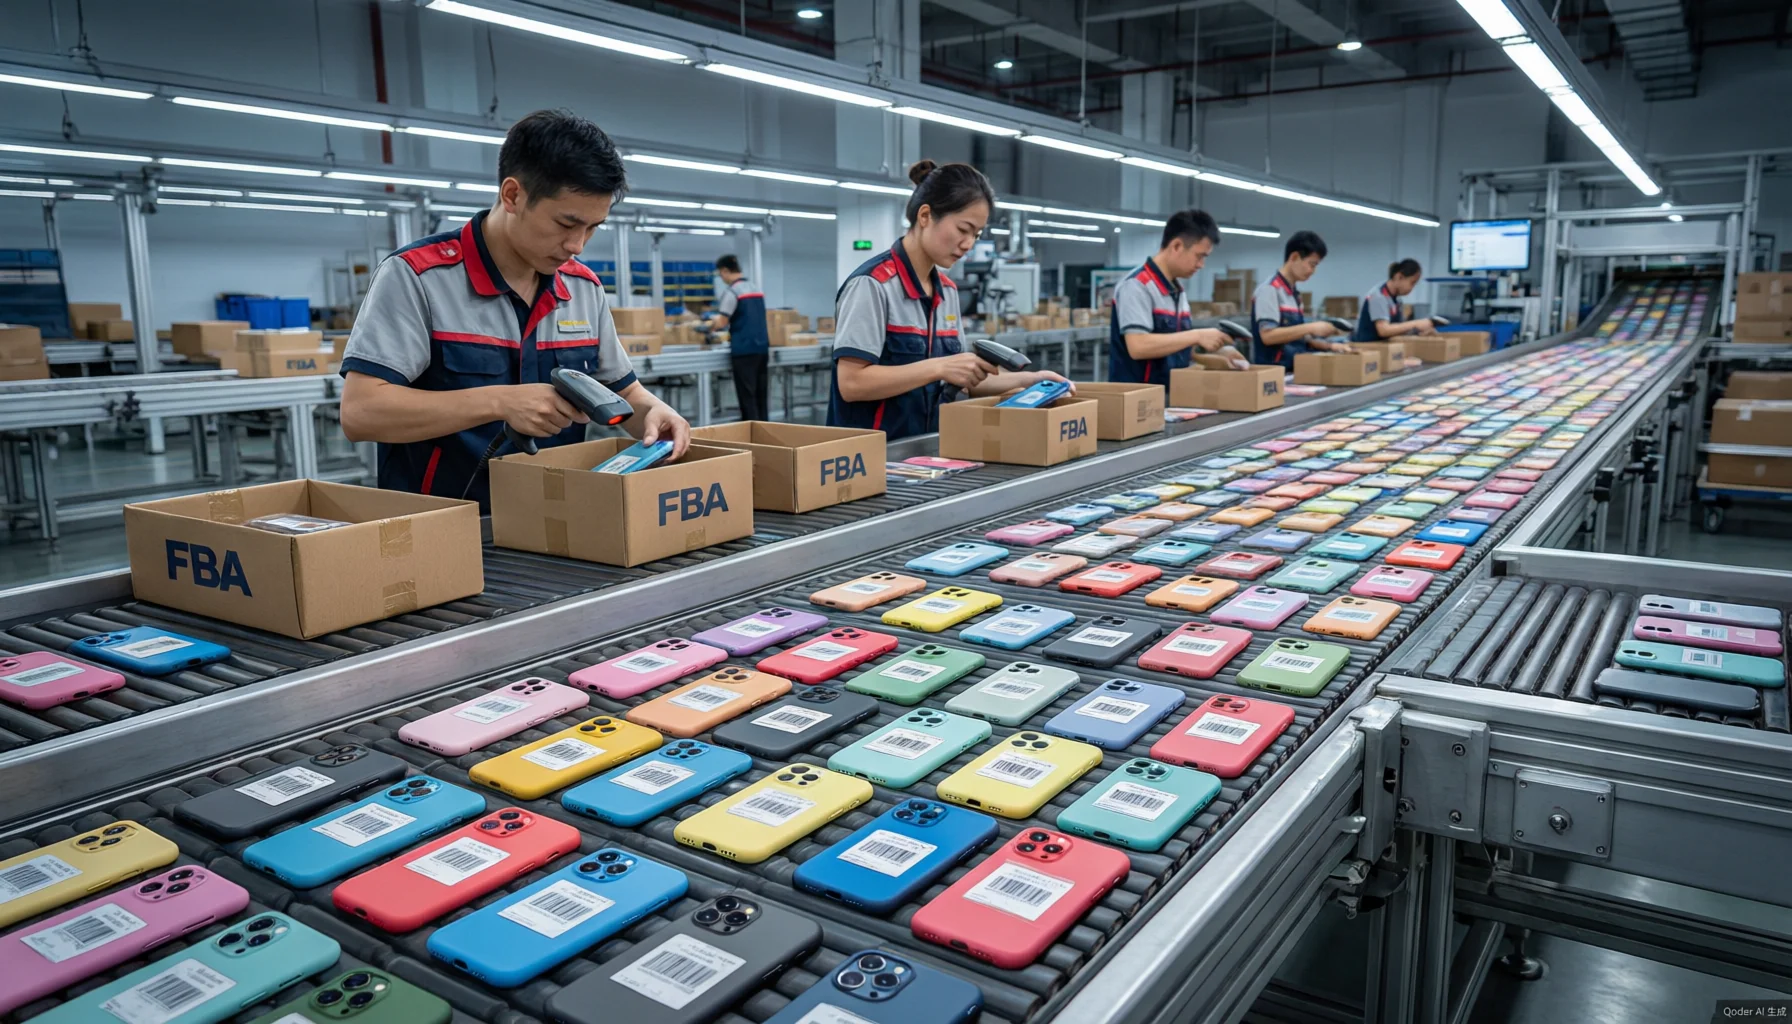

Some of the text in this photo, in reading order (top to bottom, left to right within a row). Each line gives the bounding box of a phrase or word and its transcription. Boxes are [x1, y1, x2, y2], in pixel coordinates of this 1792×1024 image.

[1060, 416, 1088, 442] FBA
[820, 453, 867, 486] FBA
[658, 482, 729, 526] FBA
[165, 539, 253, 598] FBA
